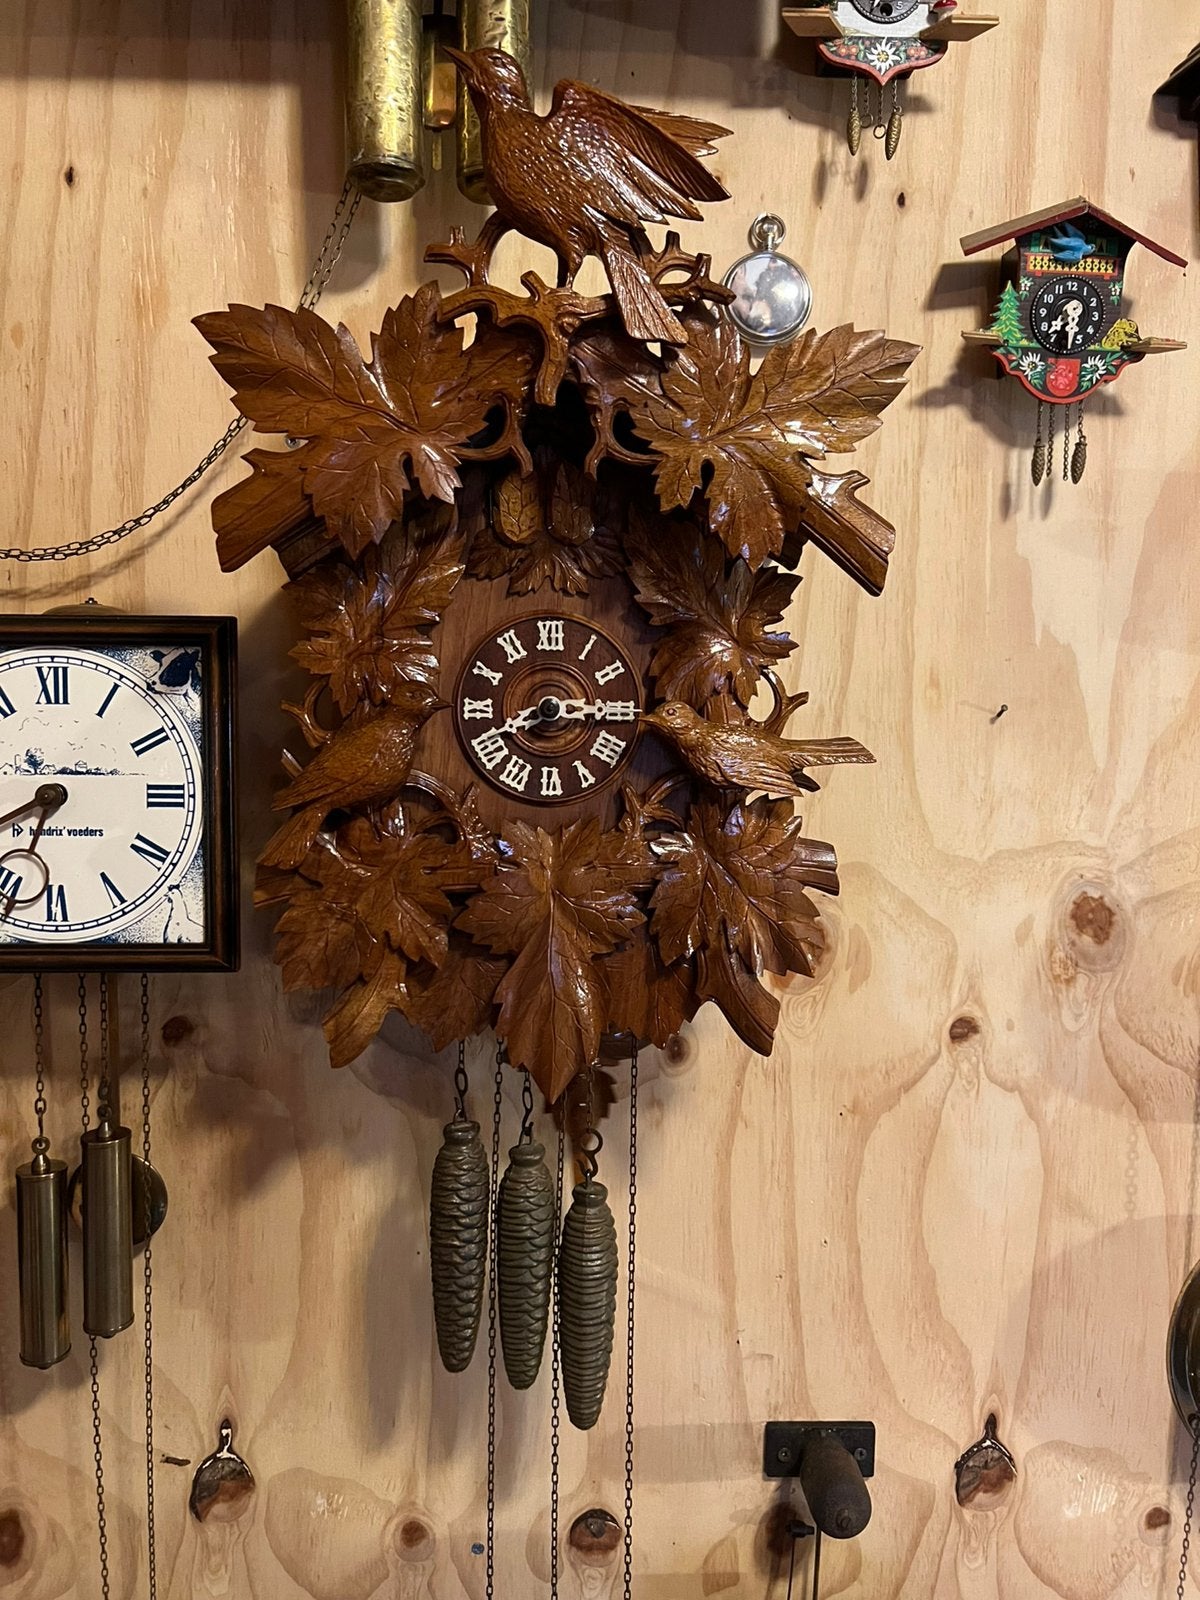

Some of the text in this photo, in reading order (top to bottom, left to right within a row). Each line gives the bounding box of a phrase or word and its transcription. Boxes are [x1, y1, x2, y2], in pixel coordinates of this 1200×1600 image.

[1055, 285, 1063, 294] 11
[1066, 281, 1078, 291] 12
[1083, 286, 1088, 296] 1
[1044, 294, 1054, 304] 10
[1089, 298, 1097, 307] 2
[1039, 308, 1047, 317] 9
[1092, 312, 1099, 321] 3
[1041, 322, 1048, 331] 8
[1087, 325, 1094, 335] 4
[1050, 333, 1057, 342] 7
[1075, 334, 1083, 344] 5
[537, 620, 564, 651] XII
[497, 629, 527, 664] XI
[578, 634, 597, 660] I
[472, 660, 503, 686] X
[595, 659, 625, 685] II
[35, 666, 70, 705] XII
[96, 682, 121, 718] I
[130, 726, 171, 757] II
[147, 783, 185, 808] III
[29, 826, 104, 836] hndrix' voeders
[100, 872, 127, 908] V
[46, 884, 69, 922] VI
